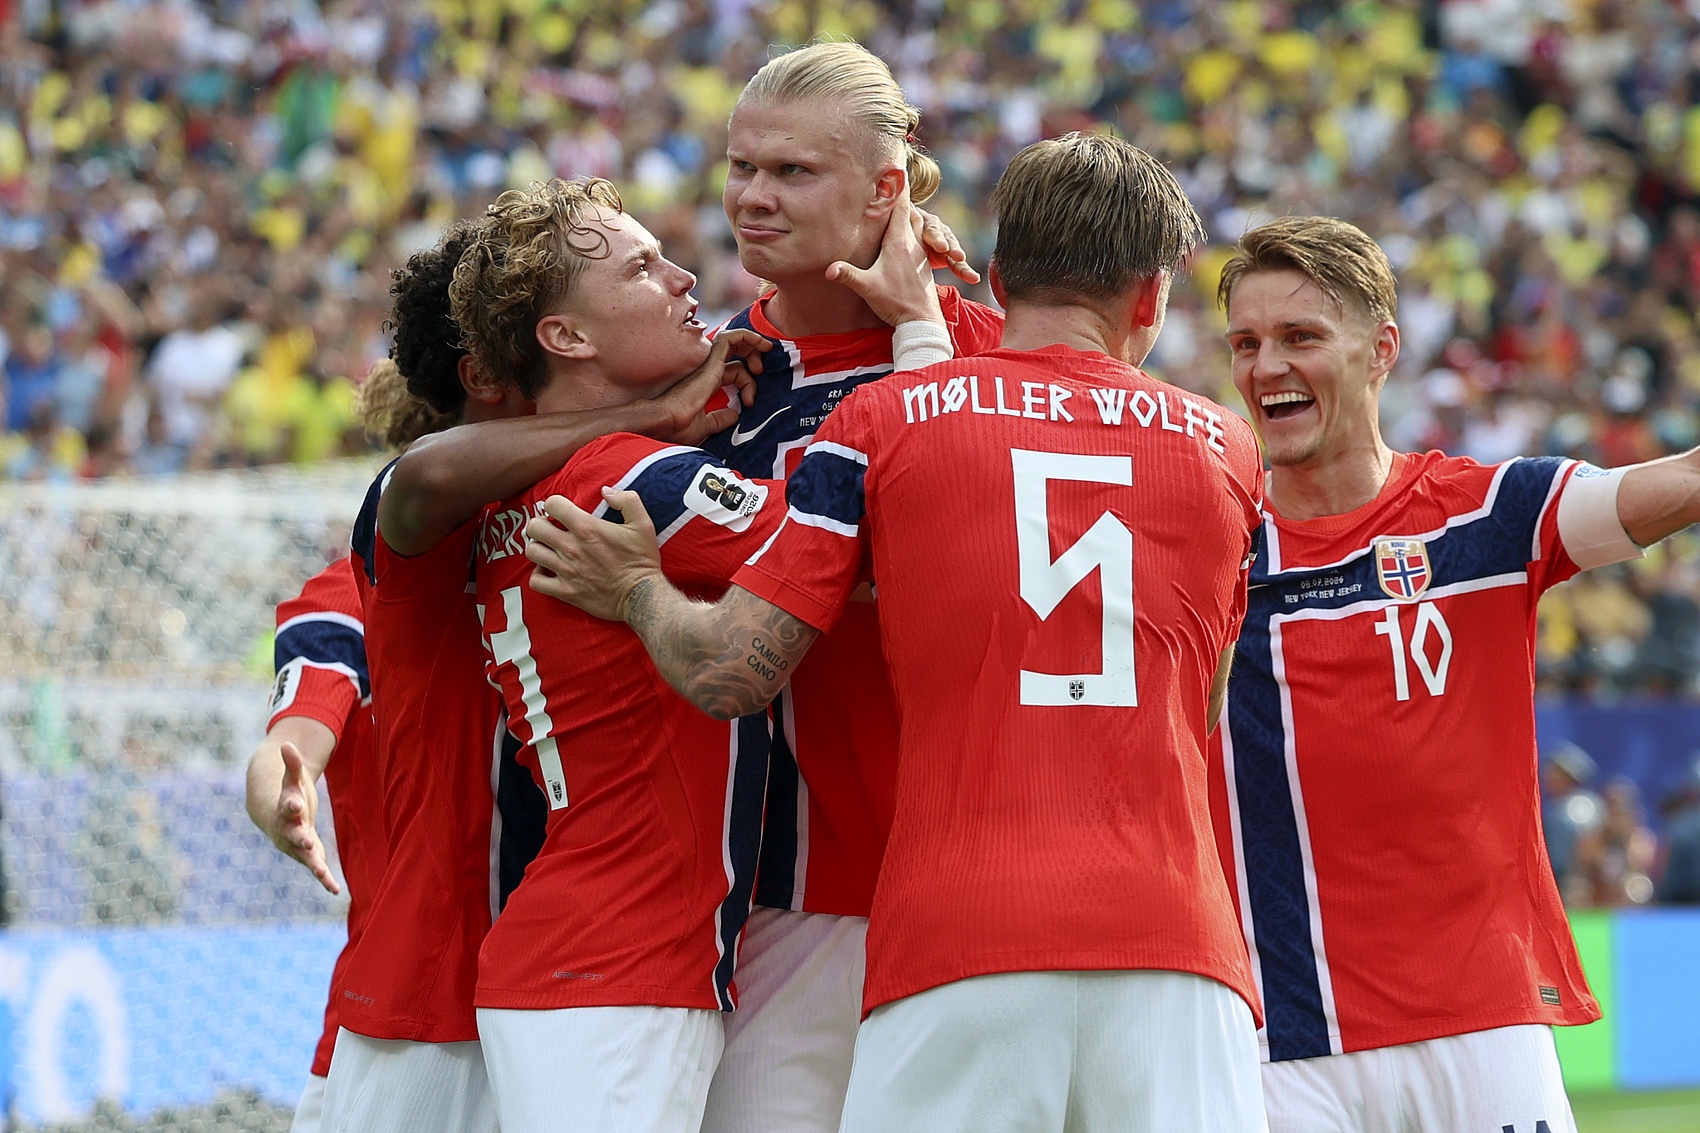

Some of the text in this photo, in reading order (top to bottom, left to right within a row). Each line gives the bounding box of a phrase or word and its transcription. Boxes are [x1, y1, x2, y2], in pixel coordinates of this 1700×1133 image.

[800, 416, 817, 427] NEW
[903, 376, 1225, 454] MØLLER WOLFE
[744, 494, 759, 518] 2026
[1010, 447, 1138, 707] 5
[1285, 594, 1299, 603] NEW
[1300, 590, 1318, 601] YORK
[1319, 589, 1335, 599] NEW
[752, 637, 788, 671] CAMILO
[1374, 601, 1453, 701] 10
[747, 654, 776, 681] CANO
